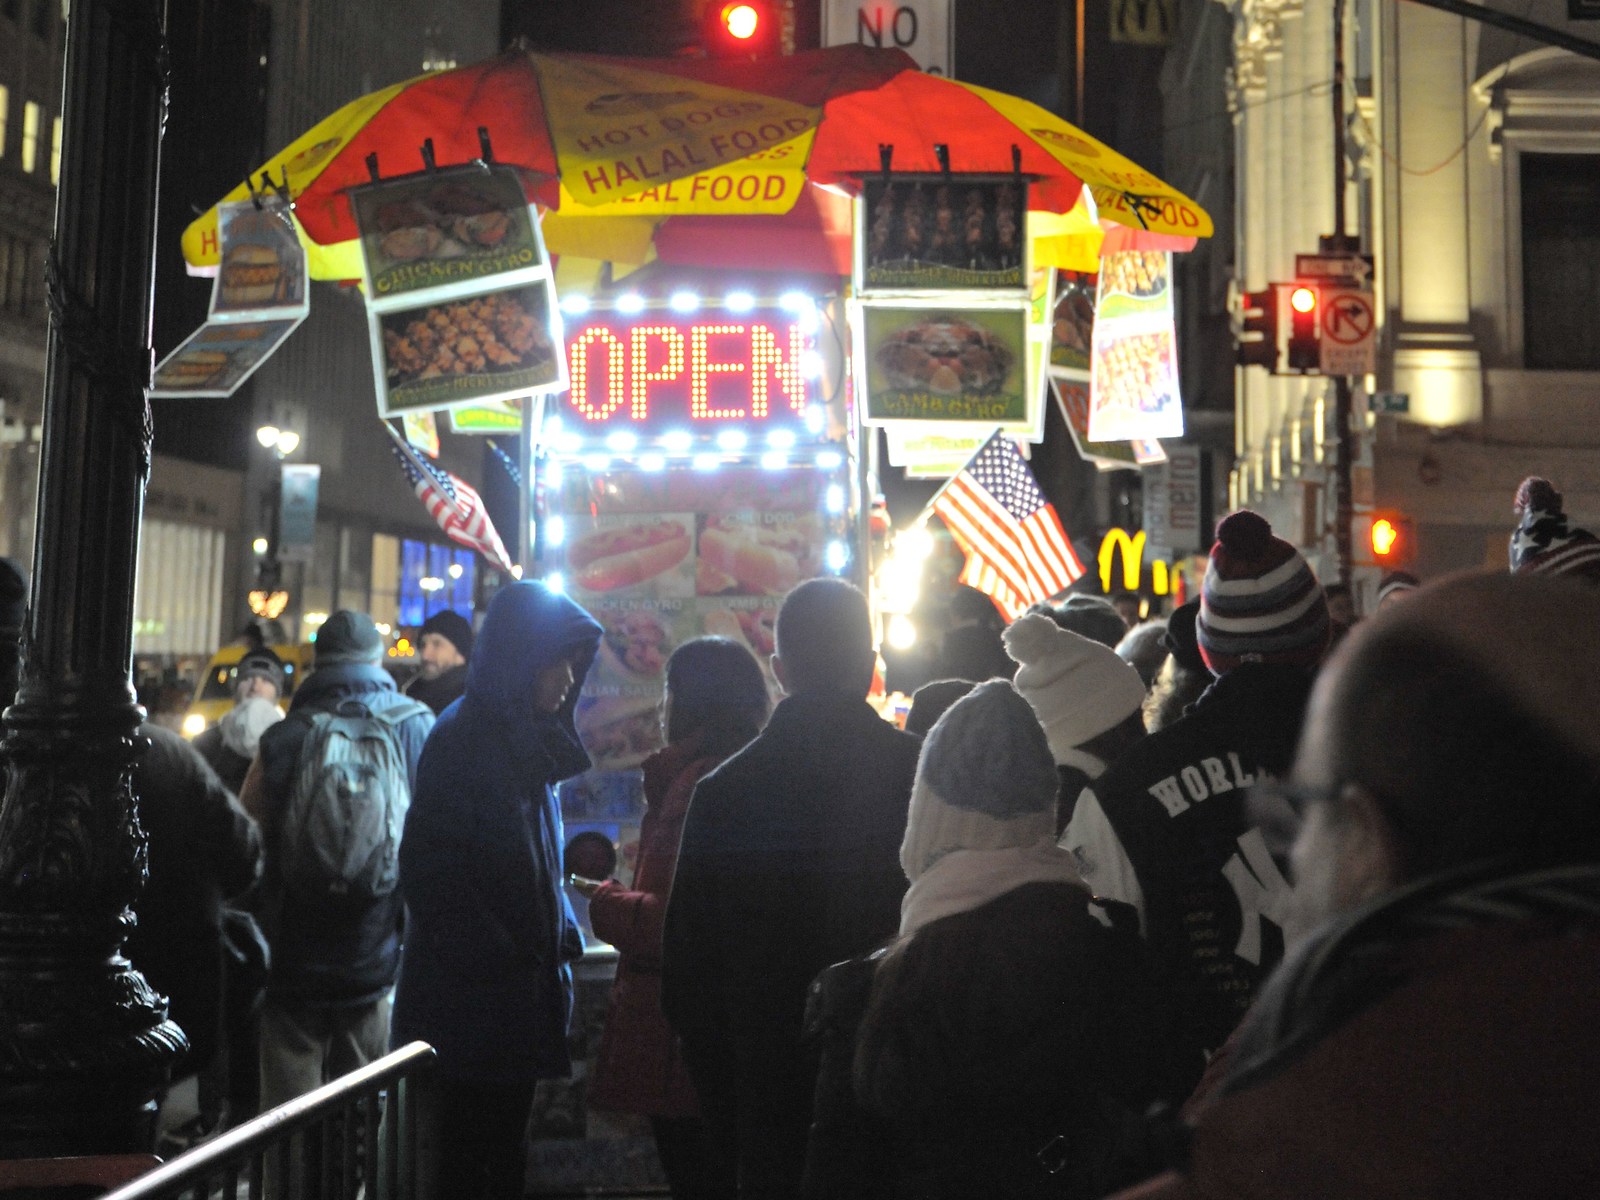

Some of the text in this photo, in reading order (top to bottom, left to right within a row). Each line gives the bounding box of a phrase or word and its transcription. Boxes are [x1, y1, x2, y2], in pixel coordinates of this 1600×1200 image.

[858, 5, 918, 49] NO
[576, 101, 766, 153] HOT DOGS
[582, 144, 704, 195] HALAL
[709, 116, 811, 158] FOOD
[689, 174, 787, 202] FOOD
[1143, 196, 1200, 229] OOD
[376, 248, 533, 293] CHICKEN GYRO
[570, 324, 807, 421] OPEN
[582, 599, 638, 611] HICKEN
[1147, 751, 1255, 819] WORL
